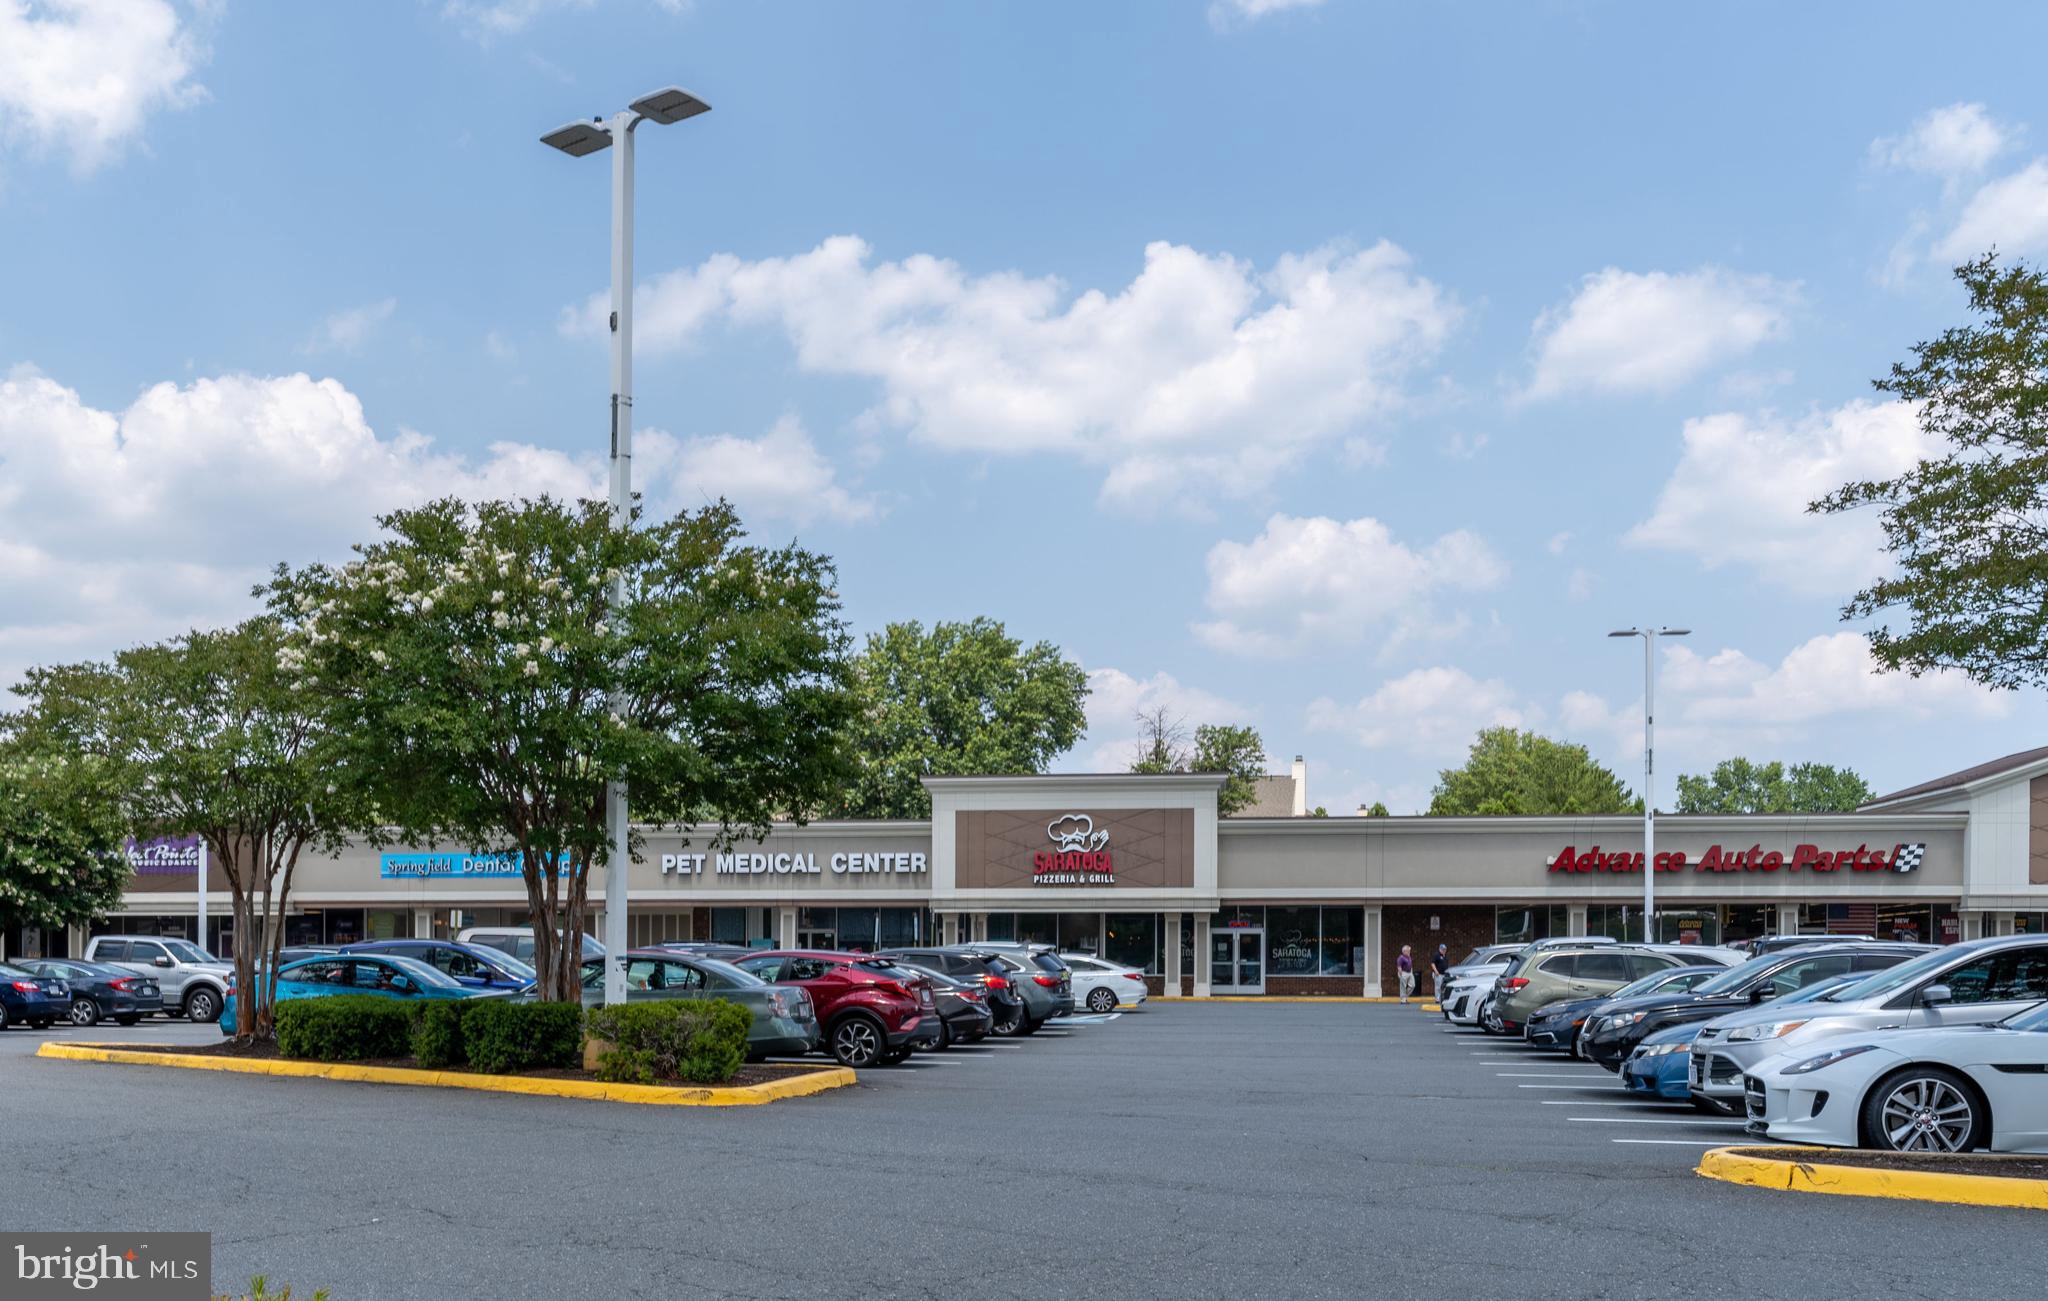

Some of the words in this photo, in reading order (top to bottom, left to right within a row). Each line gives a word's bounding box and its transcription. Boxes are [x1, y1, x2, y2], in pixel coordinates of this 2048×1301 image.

[661, 853, 706, 874] PET
[715, 853, 821, 874] MEDICAL
[830, 853, 927, 874] CENTER
[1033, 849, 1113, 874] SARATOGA
[1549, 845, 1687, 873] Advance
[1695, 844, 1784, 873] Auto
[1033, 874, 1076, 884] PIZZERIA
[1079, 874, 1085, 884] &
[1089, 874, 1115, 884] GRILL
[1272, 948, 1312, 959] SARATOGA
